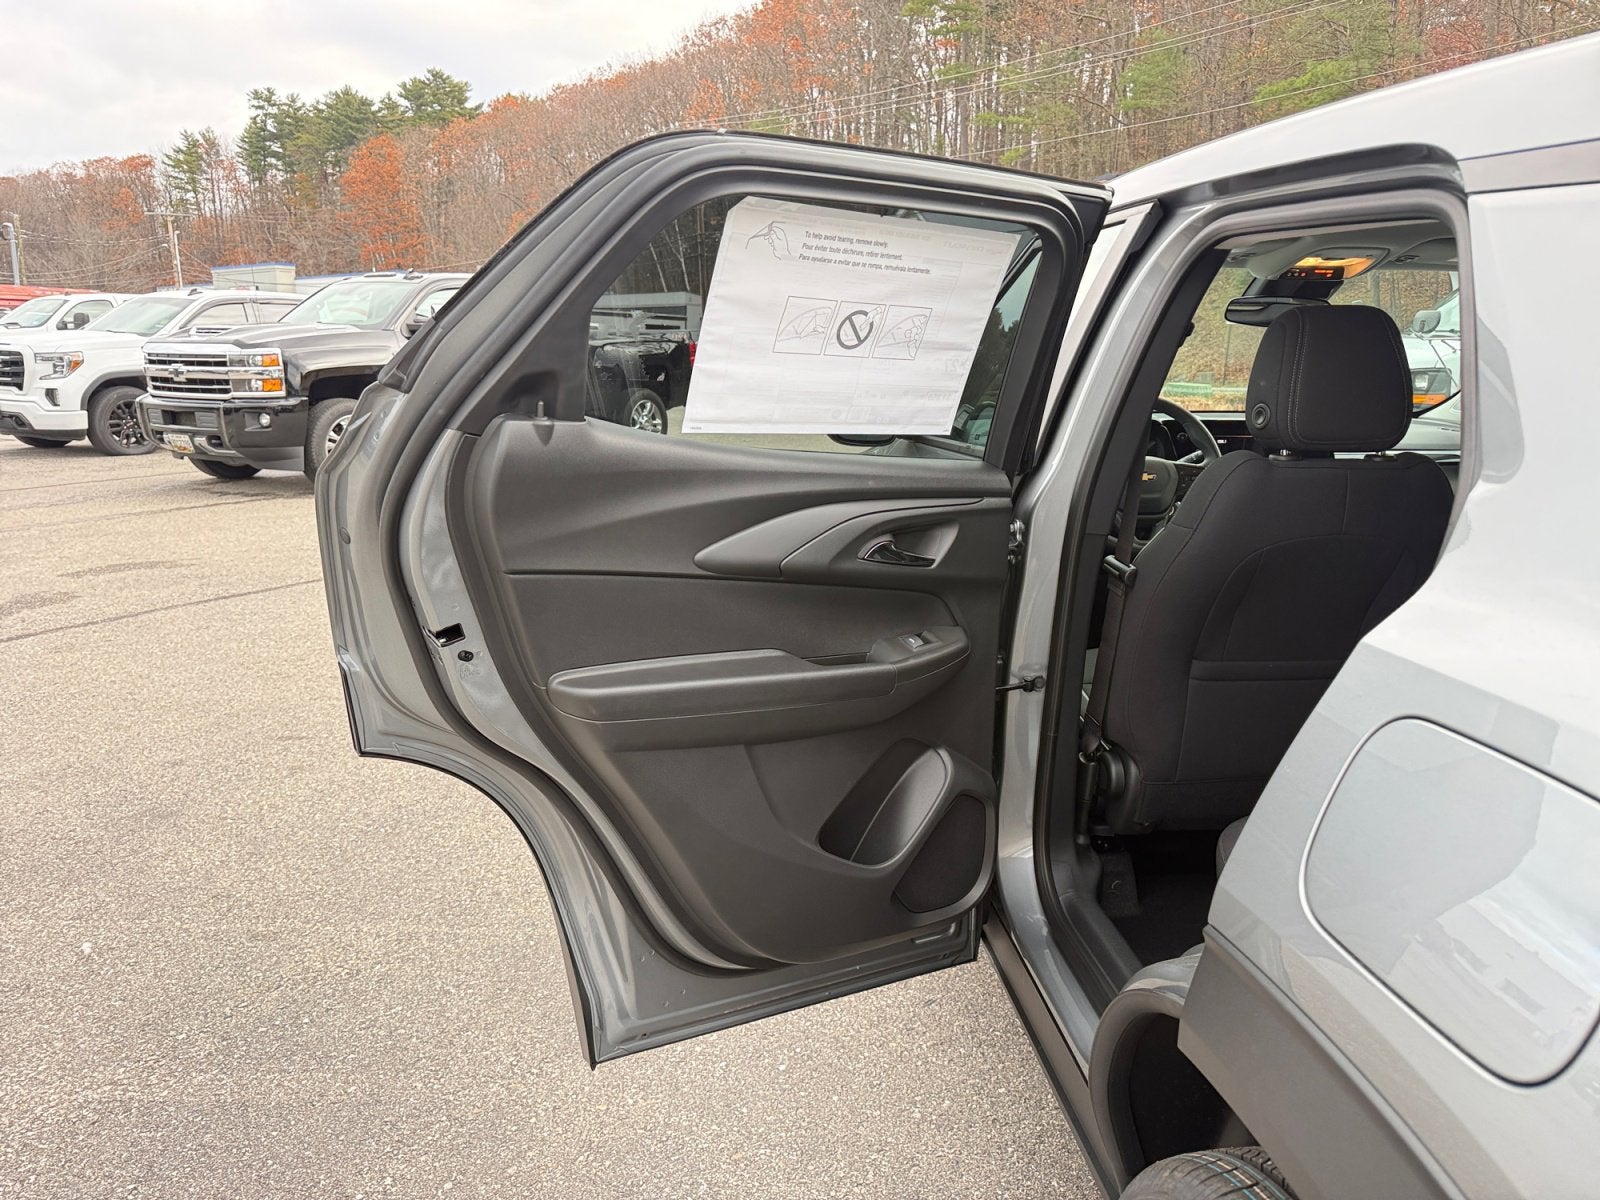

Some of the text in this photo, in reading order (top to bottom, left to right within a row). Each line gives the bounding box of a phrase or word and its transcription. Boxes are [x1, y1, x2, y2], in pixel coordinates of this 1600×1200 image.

[812, 232, 823, 240] help
[824, 234, 836, 242] avoid
[856, 238, 872, 246] remove
[829, 246, 841, 254] toute
[799, 253, 810, 261] Para
